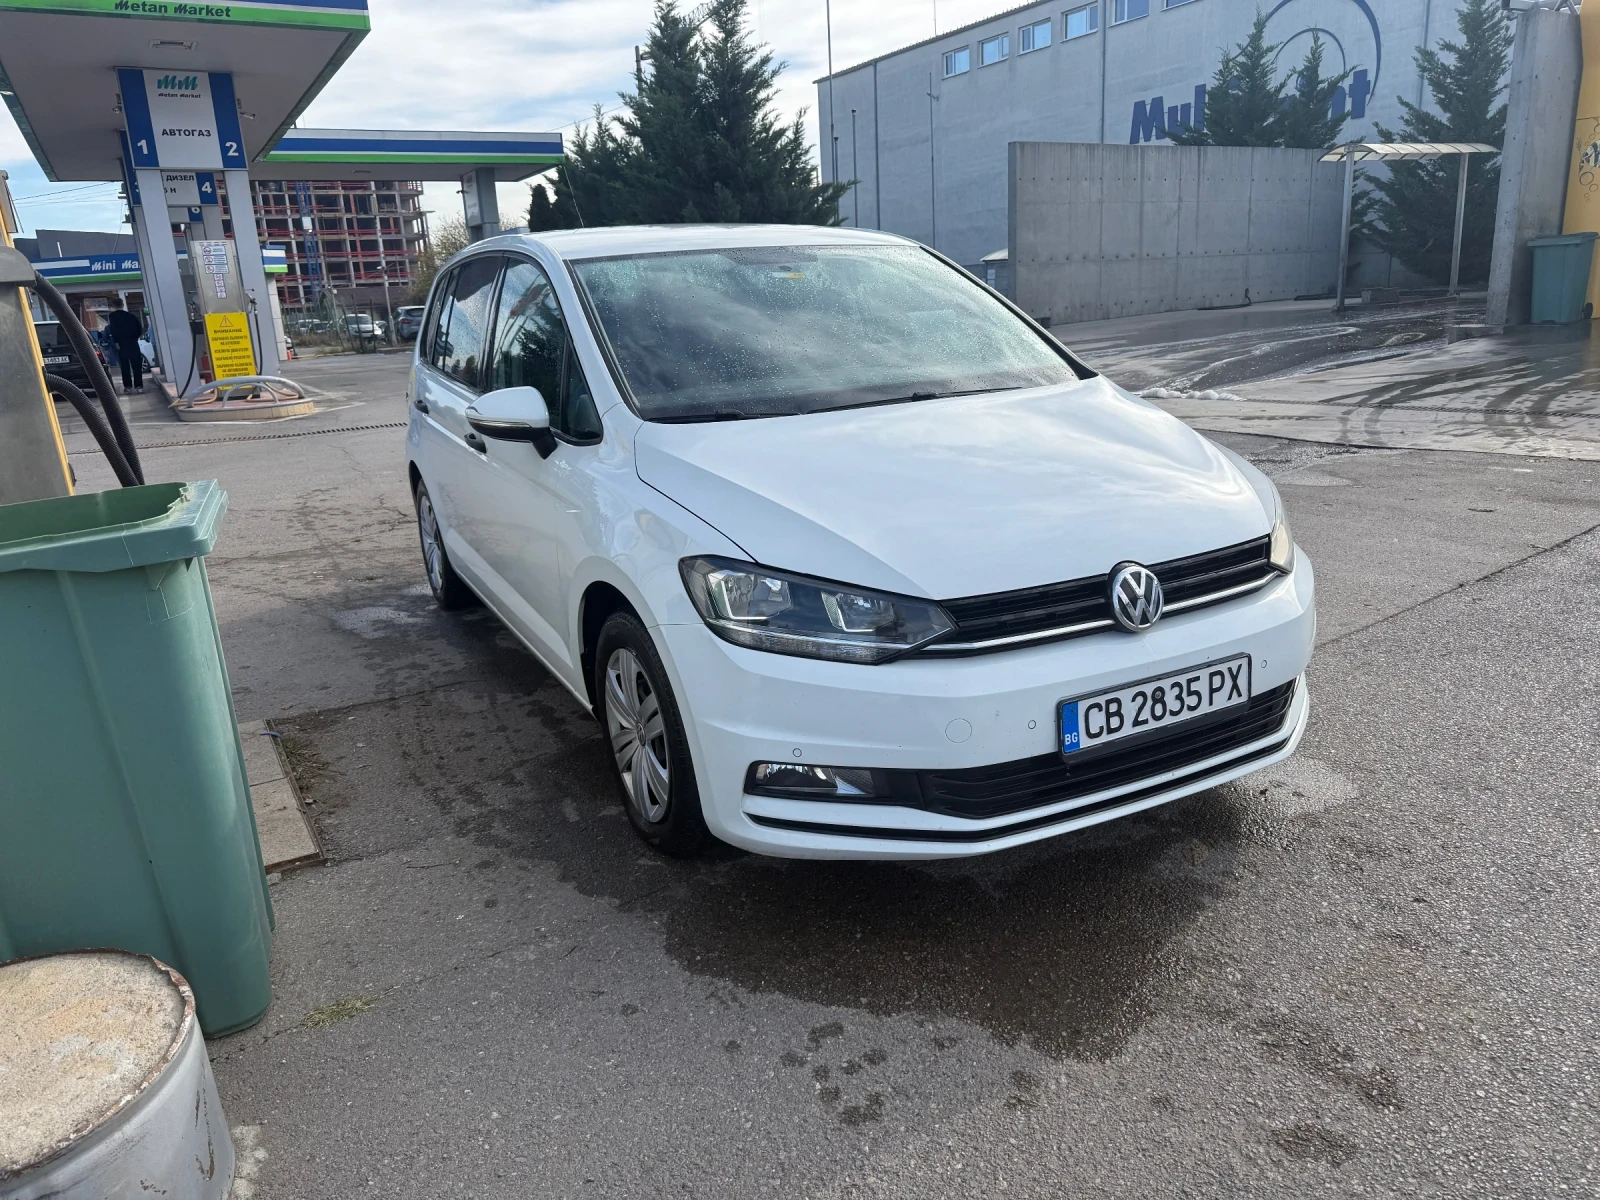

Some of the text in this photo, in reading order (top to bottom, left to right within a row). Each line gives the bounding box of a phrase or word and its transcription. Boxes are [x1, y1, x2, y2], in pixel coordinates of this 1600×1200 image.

[114, 0, 231, 17] Metan Market
[161, 129, 212, 137] АВТОГАЗ
[137, 139, 148, 154] 1
[225, 141, 239, 156] 2
[201, 181, 212, 193] 4
[91, 260, 140, 271] Mini Ma
[1084, 663, 1243, 739] CB 2835 PX
[1064, 732, 1078, 745] BG
